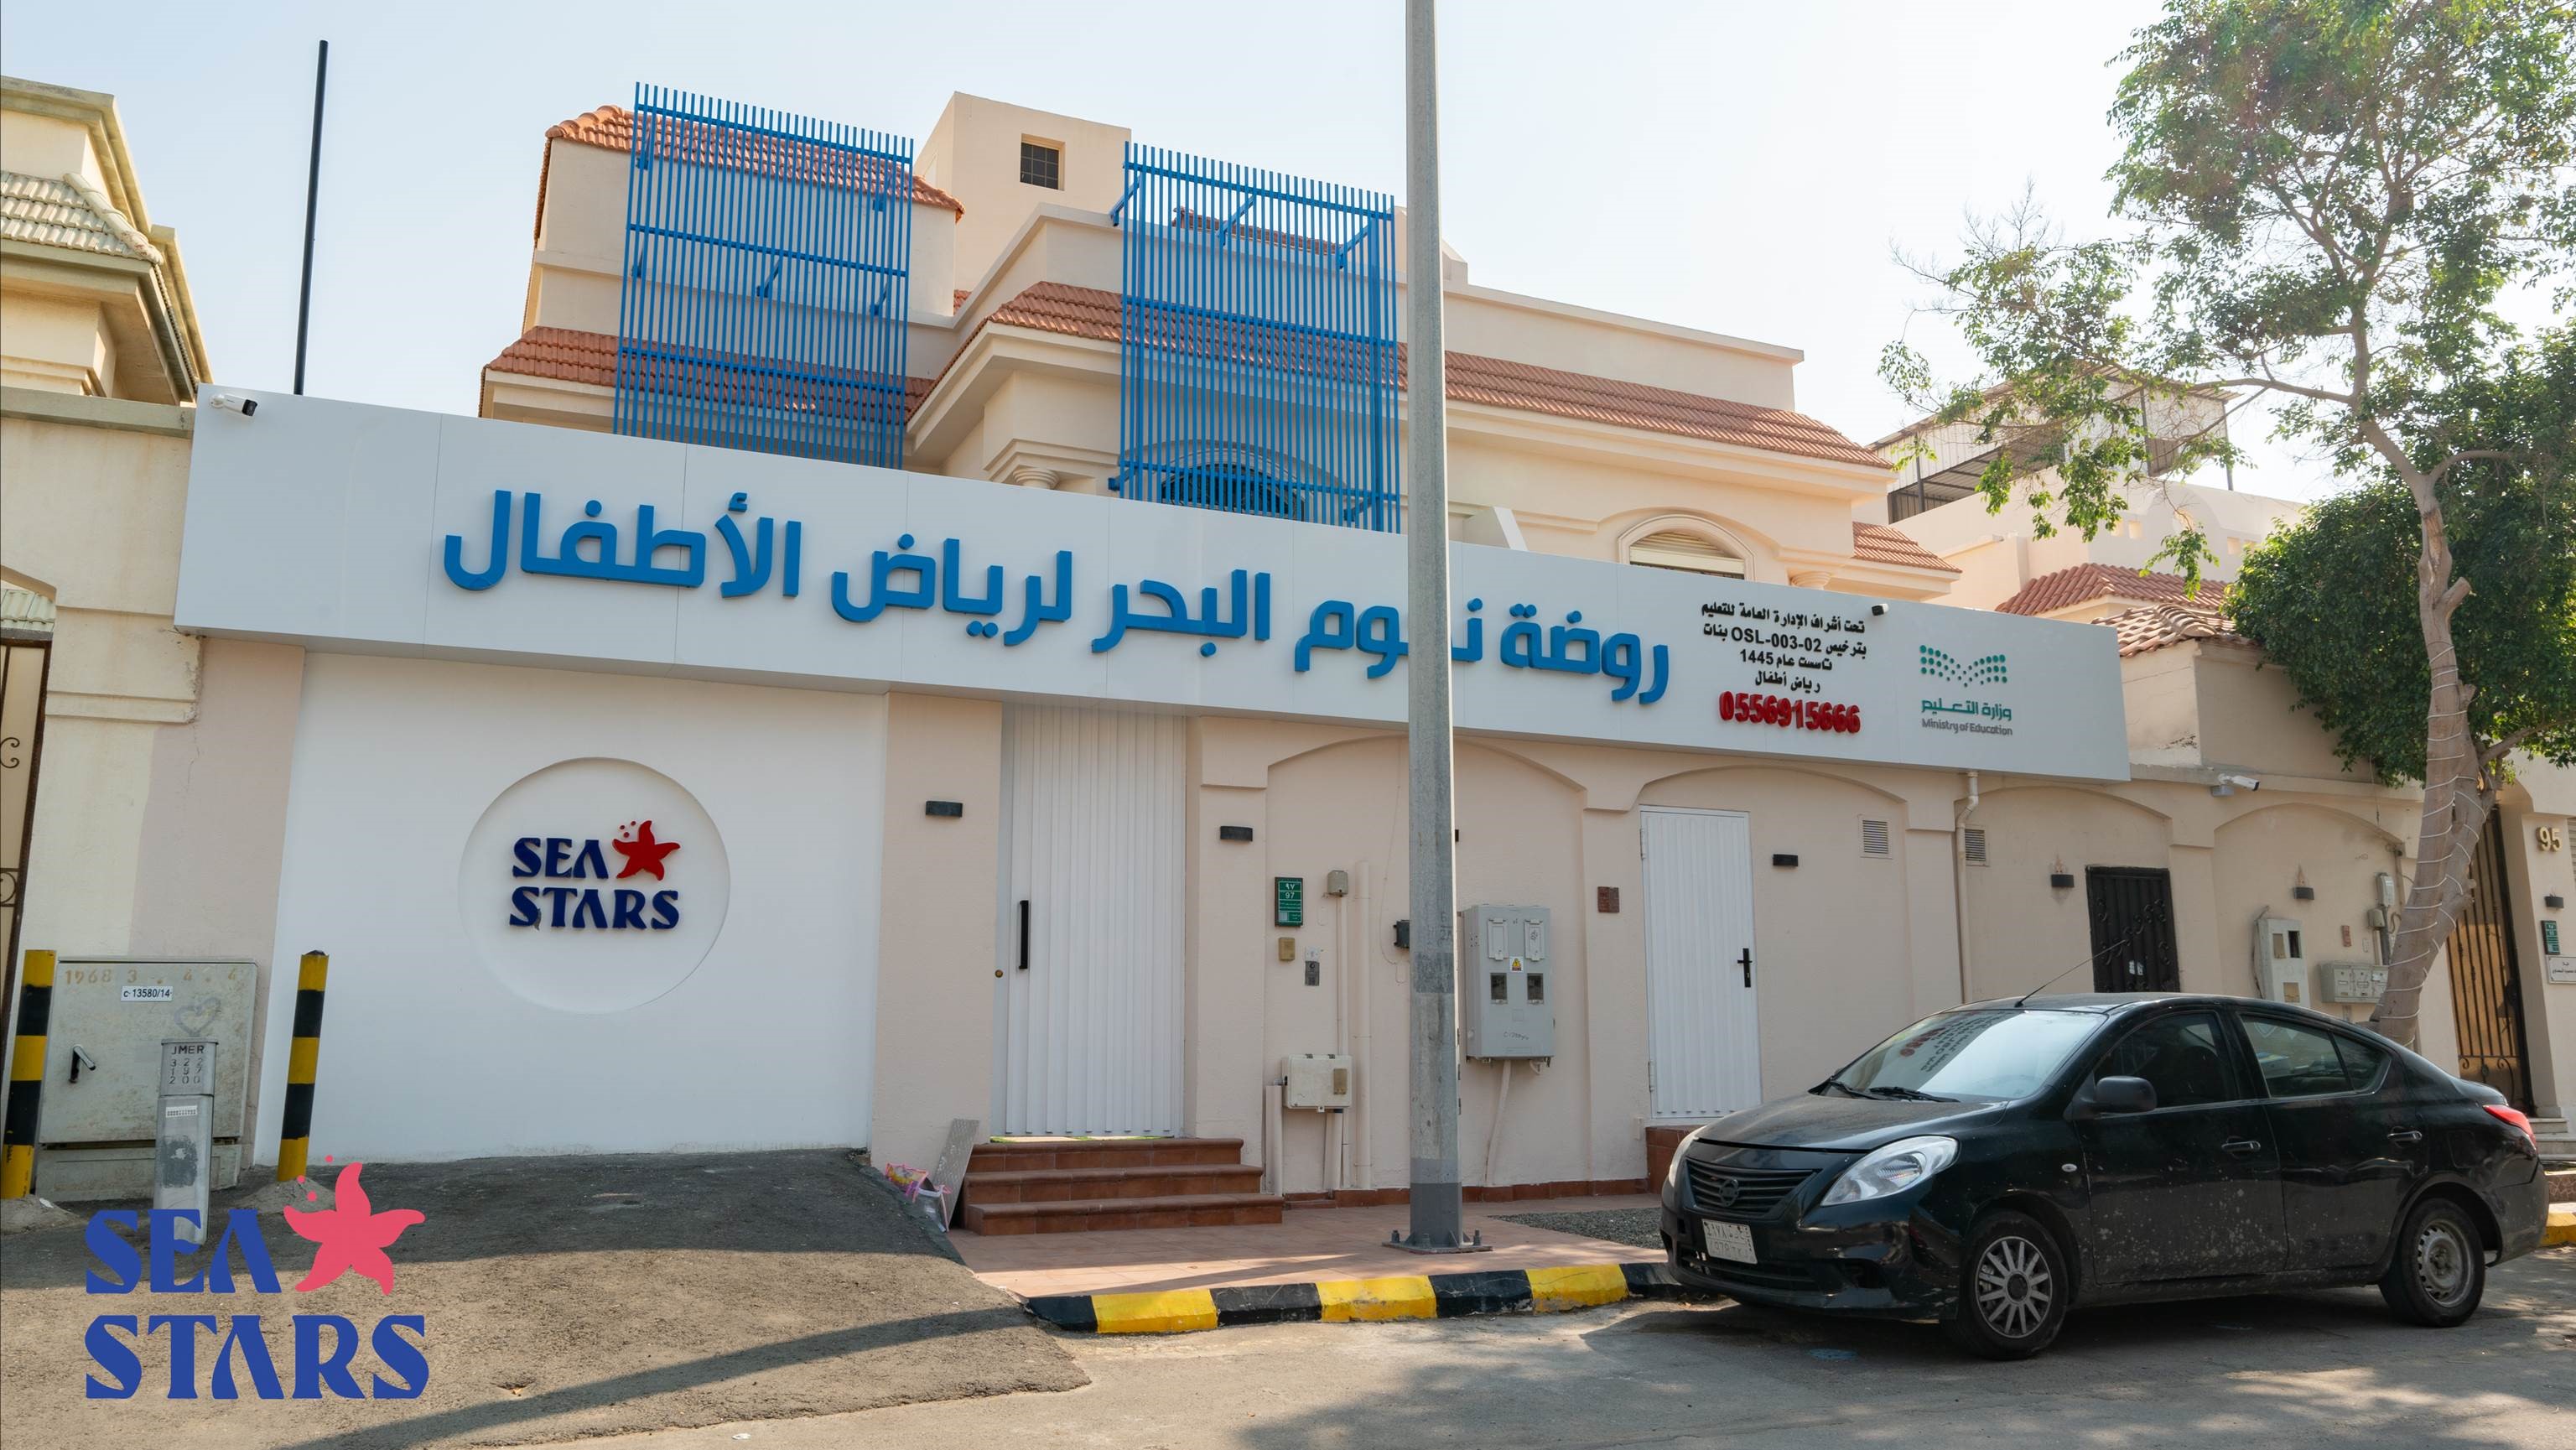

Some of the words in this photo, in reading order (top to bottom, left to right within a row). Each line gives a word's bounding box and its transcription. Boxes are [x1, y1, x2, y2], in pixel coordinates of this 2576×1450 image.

[444, 489, 802, 599] الأطفال
[830, 532, 1073, 647] لرياض
[1090, 568, 1271, 658] البحر
[1701, 601, 1736, 617] للتعليم
[1739, 602, 1770, 621] العامة
[1703, 622, 1728, 642] بنات
[1843, 619, 1866, 634] تحت
[1294, 597, 1483, 679] نوم
[1731, 626, 1822, 653] OSL-003-02
[1499, 602, 1670, 706] روضة
[1739, 648, 1774, 665] 1445
[1825, 640, 1867, 660] بترخيص
[1776, 653, 1795, 669] عام
[1790, 675, 1821, 694] رياض
[1719, 690, 1861, 734] 0556915666
[1921, 697, 1979, 715] التعليم
[1981, 702, 2012, 721] وزارة
[1921, 717, 1959, 734] Ministry
[1959, 722, 1969, 732] of
[1969, 722, 2012, 735] Education
[2537, 826, 2563, 852] 95
[512, 837, 610, 880] SEA
[1285, 891, 1296, 900] 97
[509, 886, 680, 930] STARS
[171, 1045, 205, 1055] JMER
